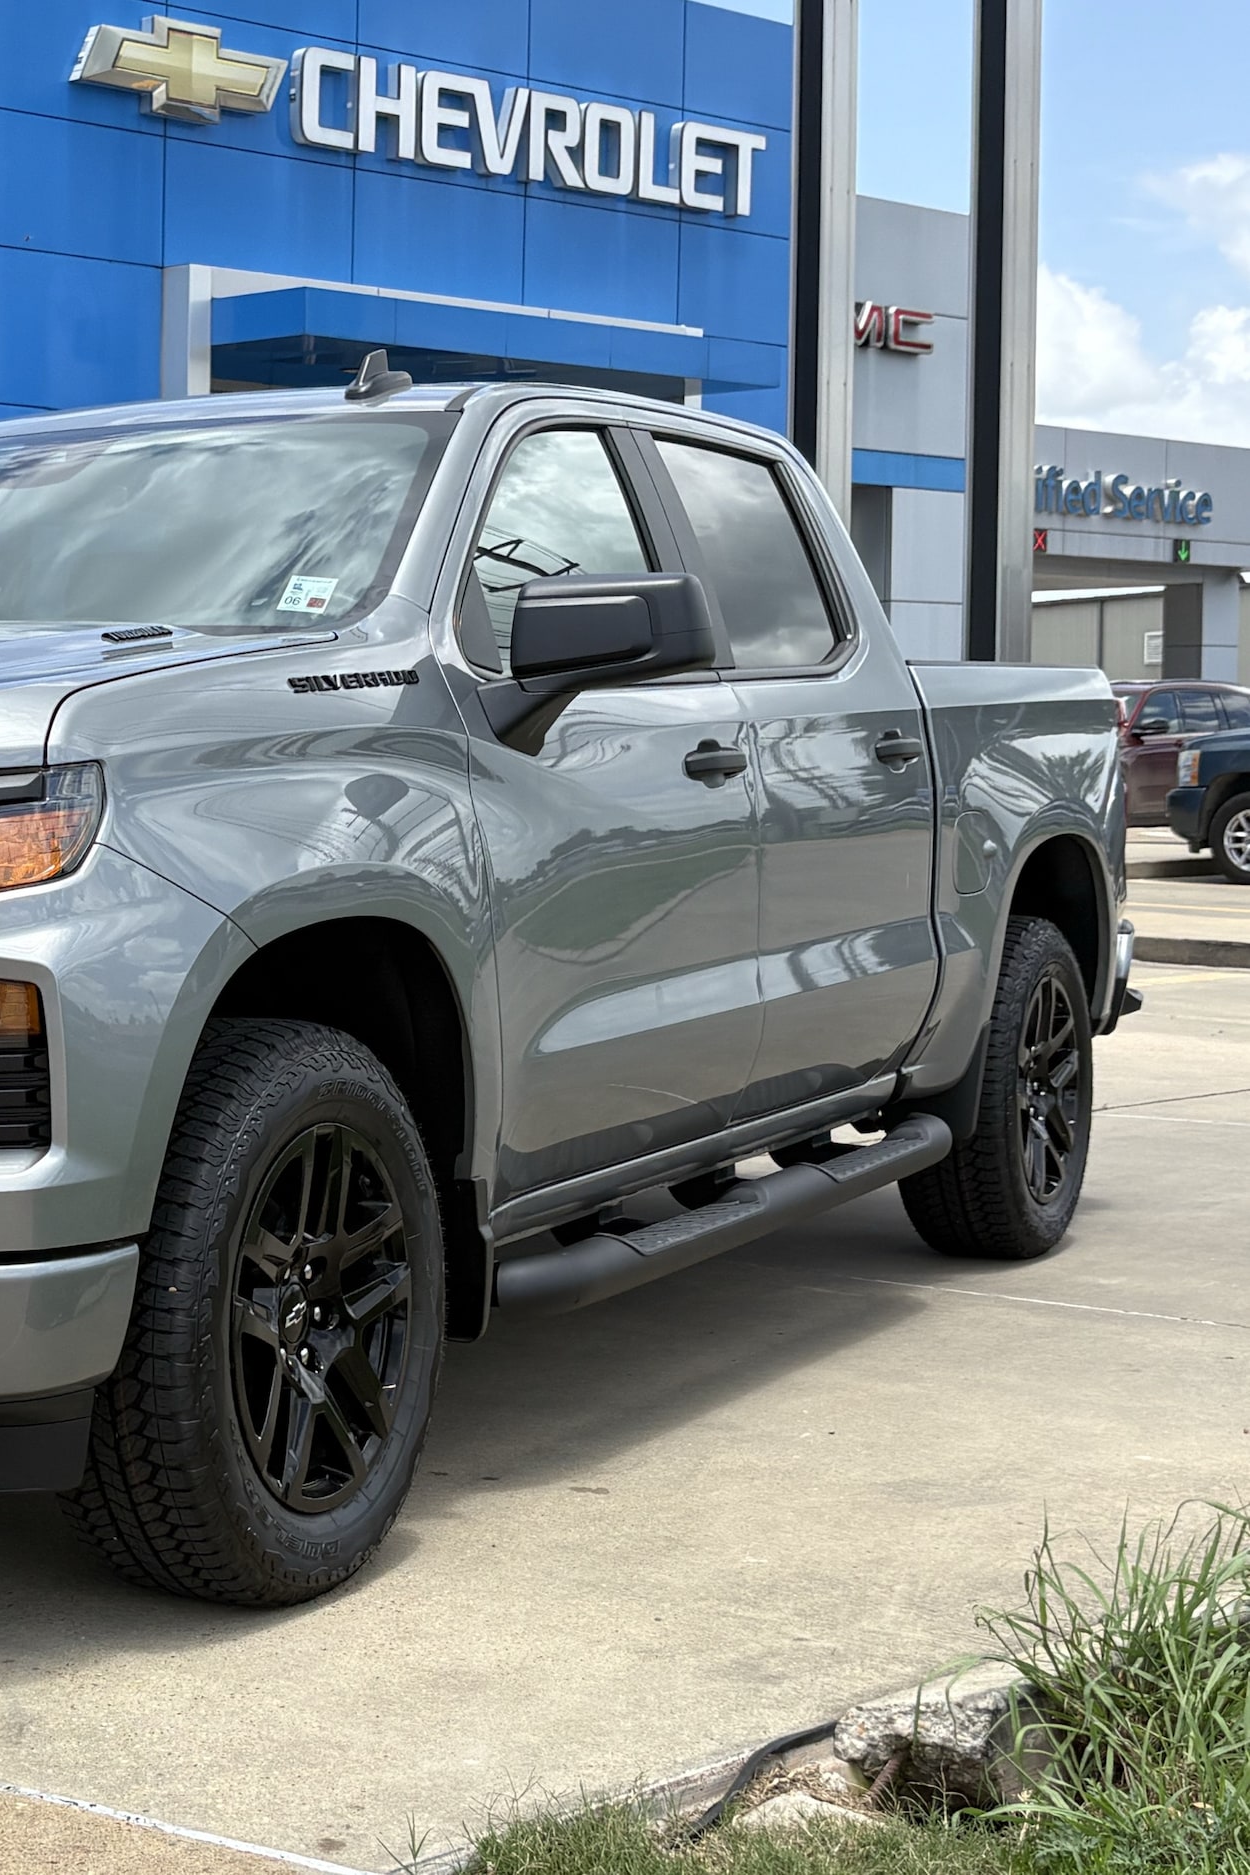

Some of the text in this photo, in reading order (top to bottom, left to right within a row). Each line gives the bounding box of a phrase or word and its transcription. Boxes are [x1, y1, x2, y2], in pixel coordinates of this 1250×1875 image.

[290, 46, 767, 218] CHEVROLET
[1105, 473, 1214, 526] Service
[284, 595, 302, 606] 06
[287, 669, 420, 694] SILVERADO
